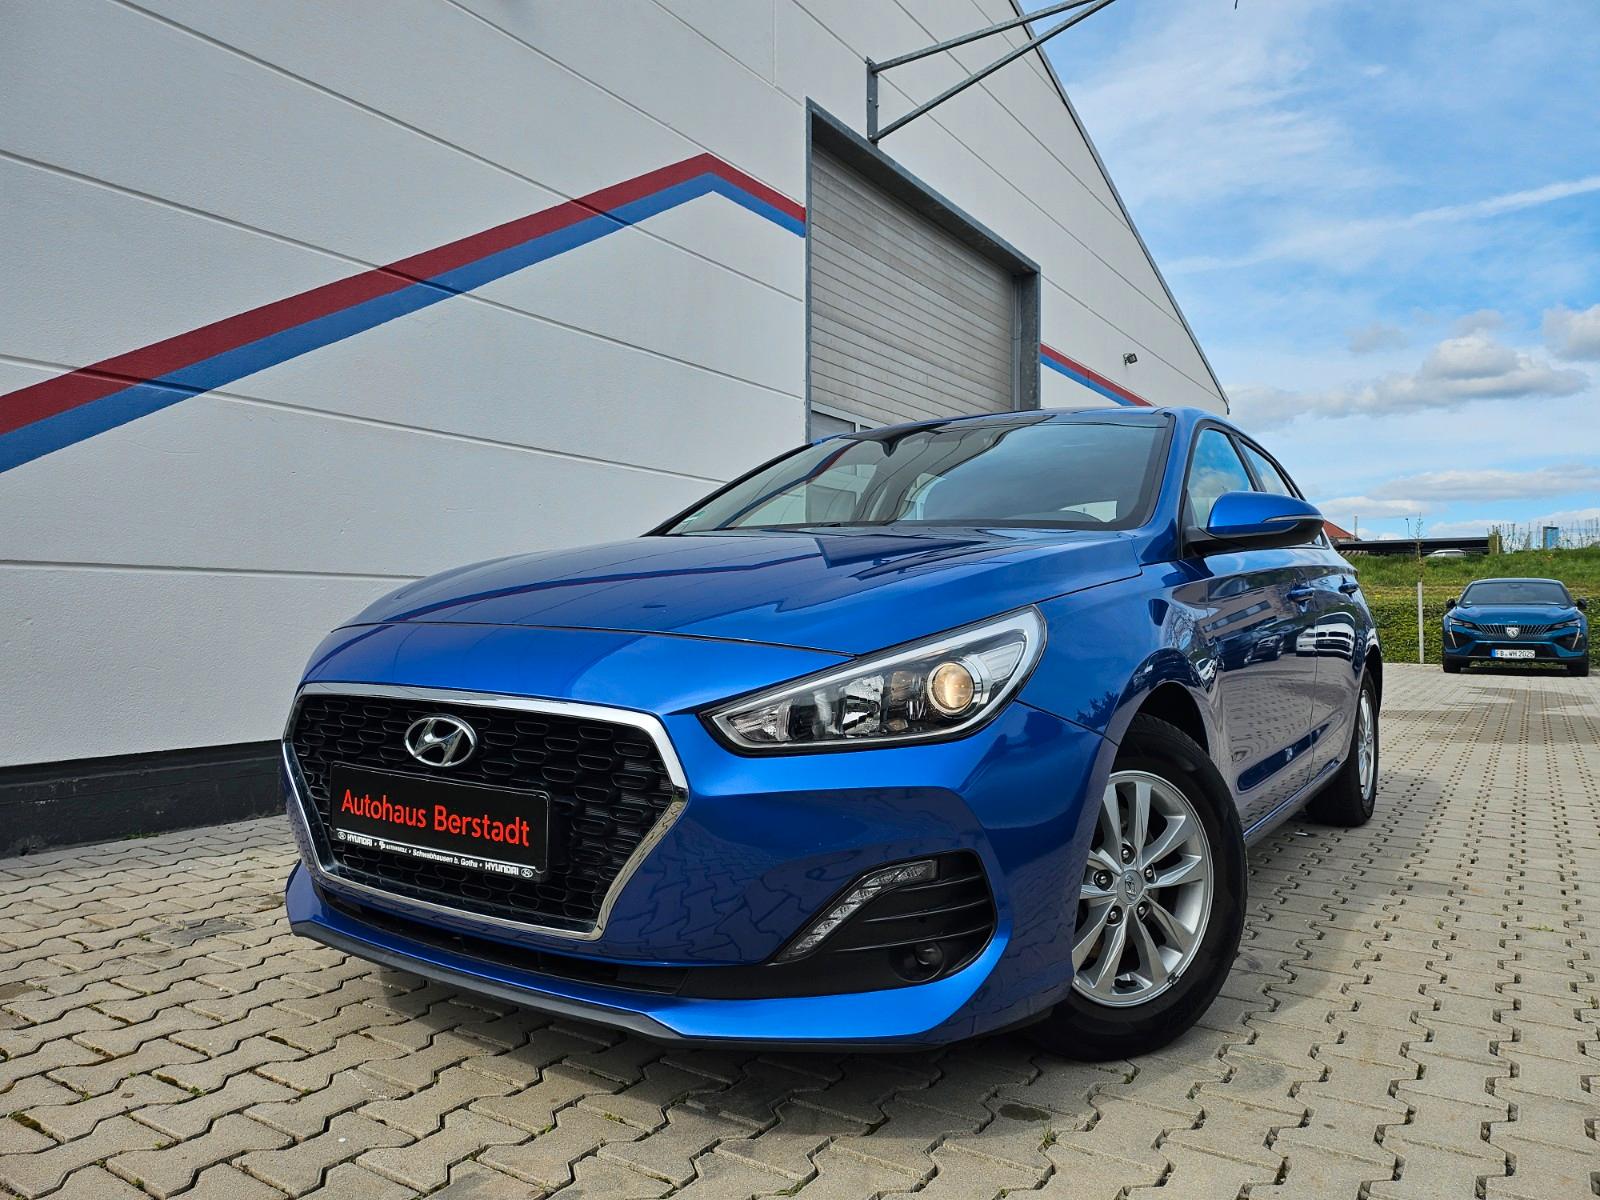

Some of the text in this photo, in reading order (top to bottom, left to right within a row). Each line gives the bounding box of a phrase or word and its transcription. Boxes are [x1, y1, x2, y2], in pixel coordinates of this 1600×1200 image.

[341, 788, 530, 847] Autohaus Berstadt
[347, 833, 373, 847] HYUNDAI
[485, 862, 519, 876] HYUNDAI
